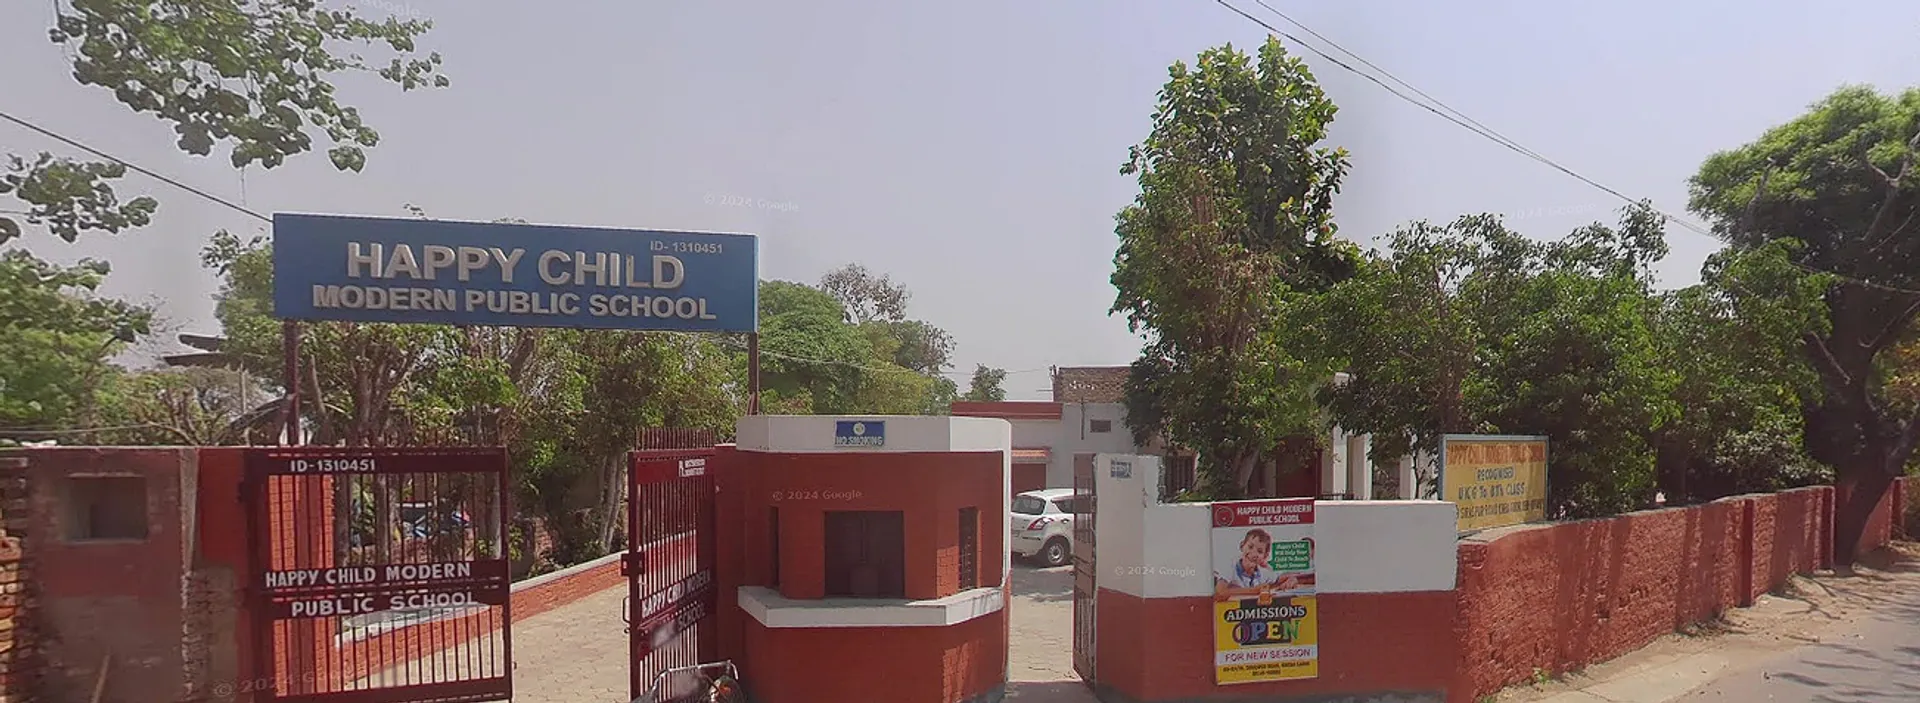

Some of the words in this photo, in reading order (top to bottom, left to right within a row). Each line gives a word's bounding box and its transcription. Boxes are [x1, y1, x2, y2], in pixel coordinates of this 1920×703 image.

[672, 242, 723, 254] 1310451
[347, 241, 526, 283] HAPPY
[538, 249, 685, 289] CHILD
[312, 284, 457, 312] MODERN
[465, 290, 581, 315] PUBLIC
[588, 294, 717, 320] SCHOOL
[290, 459, 376, 472] ID-1310451
[1237, 506, 1260, 516] HAPPY
[1261, 505, 1281, 514] CHILD
[1283, 504, 1312, 513] MODERN
[1249, 516, 1272, 525] PUBLIC
[1274, 514, 1300, 523] SCHOOL
[265, 570, 320, 588] HAPPY
[325, 568, 376, 584] CHILD
[386, 562, 471, 581] MODERN
[291, 597, 375, 617] PUBLIC
[390, 591, 478, 611] SCHOOL
[1226, 606, 1305, 621] ADMISSIONS
[1232, 619, 1301, 644] OPEN
[1225, 652, 1244, 662] FOR
[1246, 651, 1268, 660] NEW
[1270, 648, 1311, 659] SESSION
